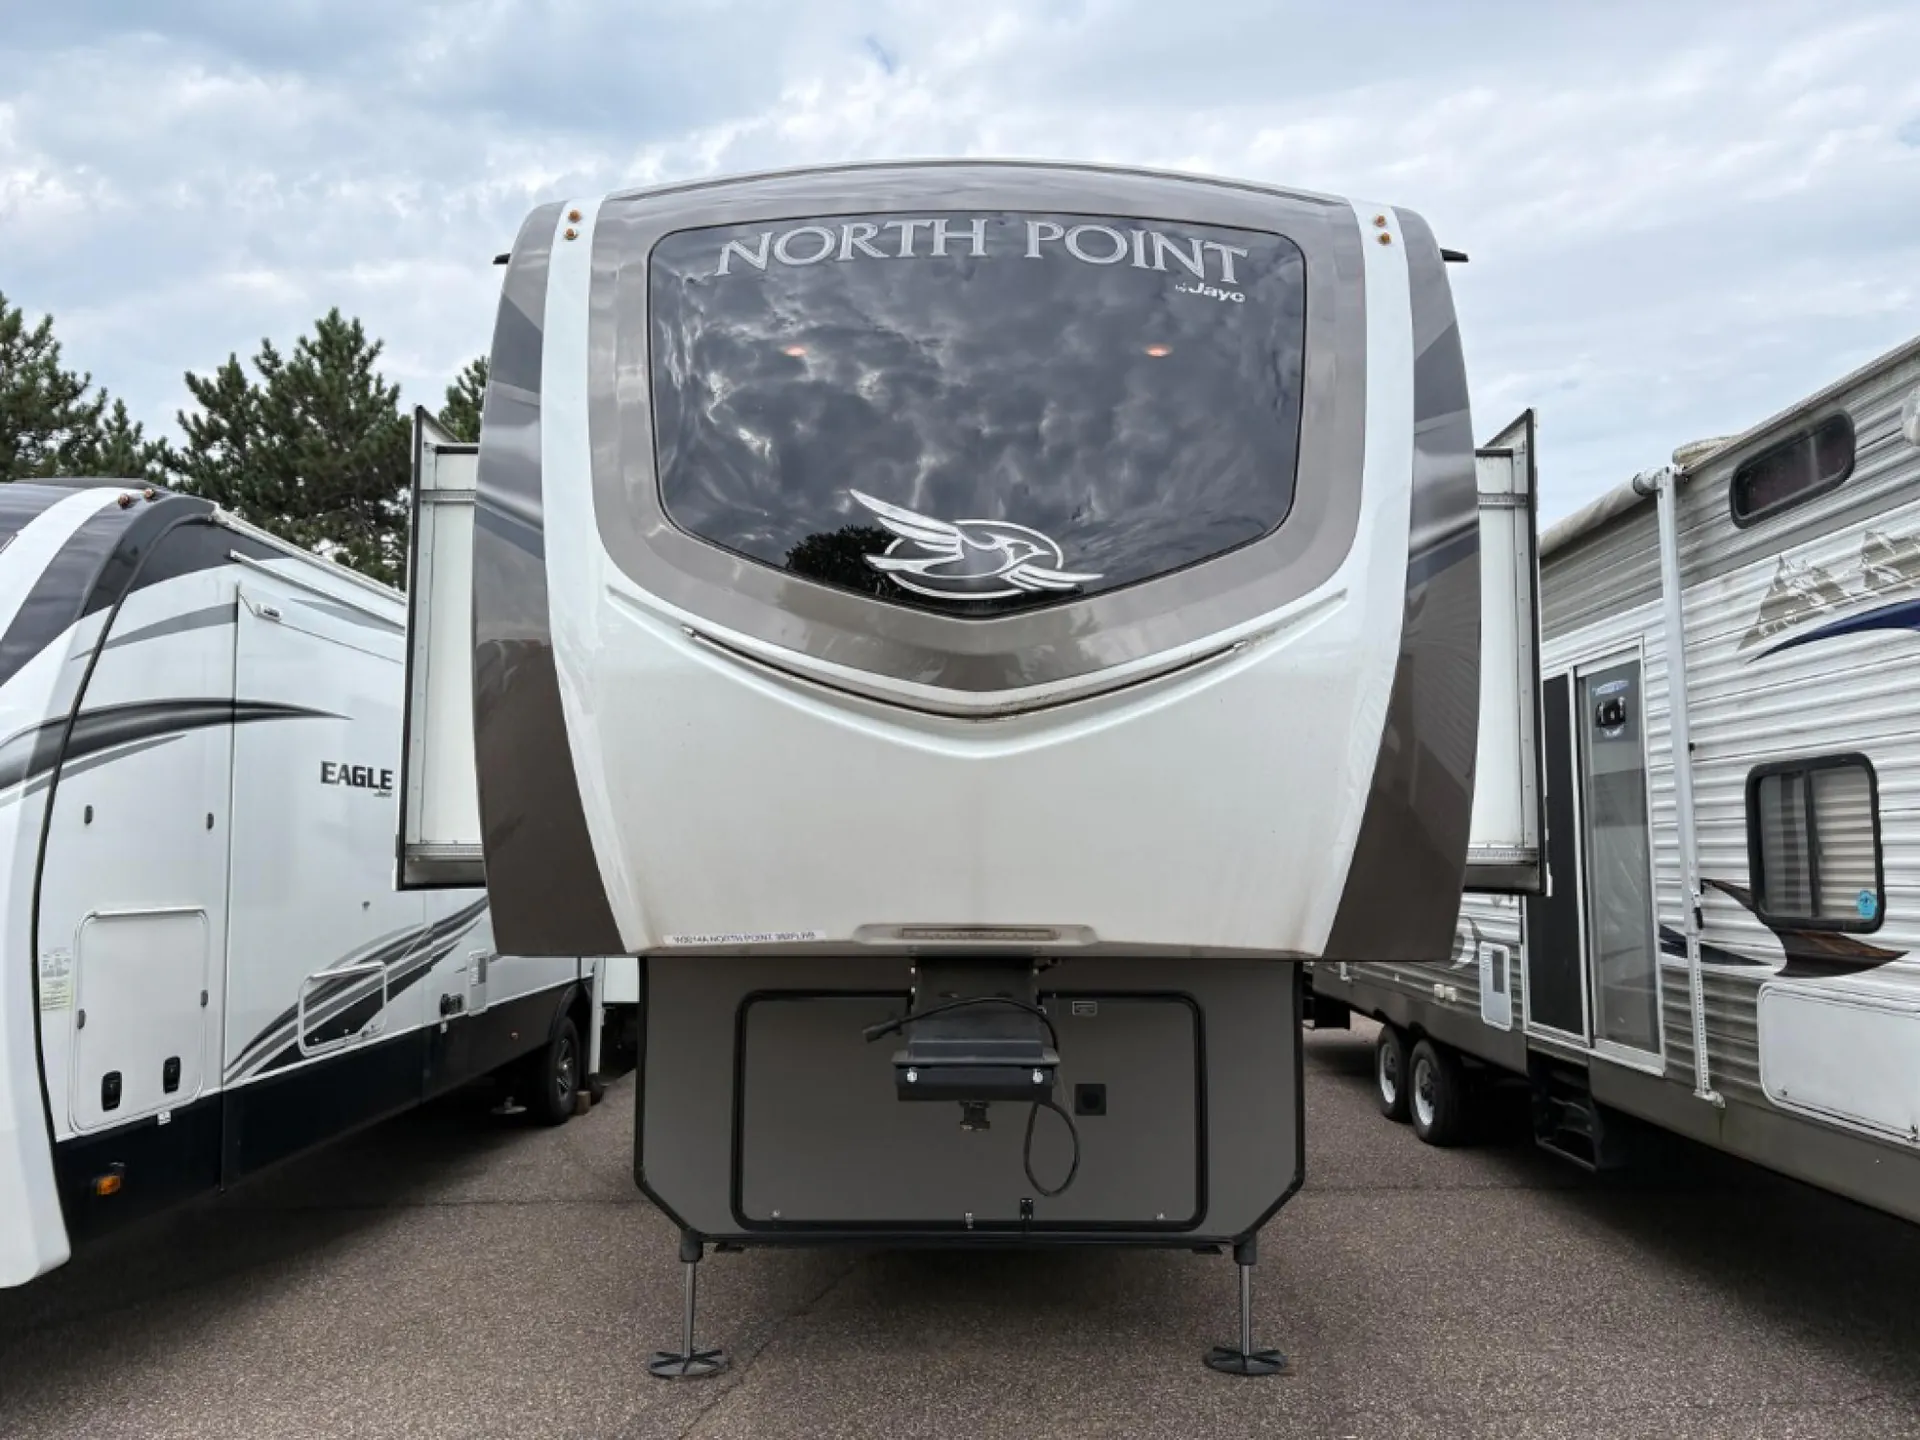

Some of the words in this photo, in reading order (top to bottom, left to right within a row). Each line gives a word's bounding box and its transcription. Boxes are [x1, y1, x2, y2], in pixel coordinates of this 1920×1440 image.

[714, 218, 989, 277] NORTH
[1024, 220, 1249, 284] POINT
[320, 760, 394, 790] EAGLE
